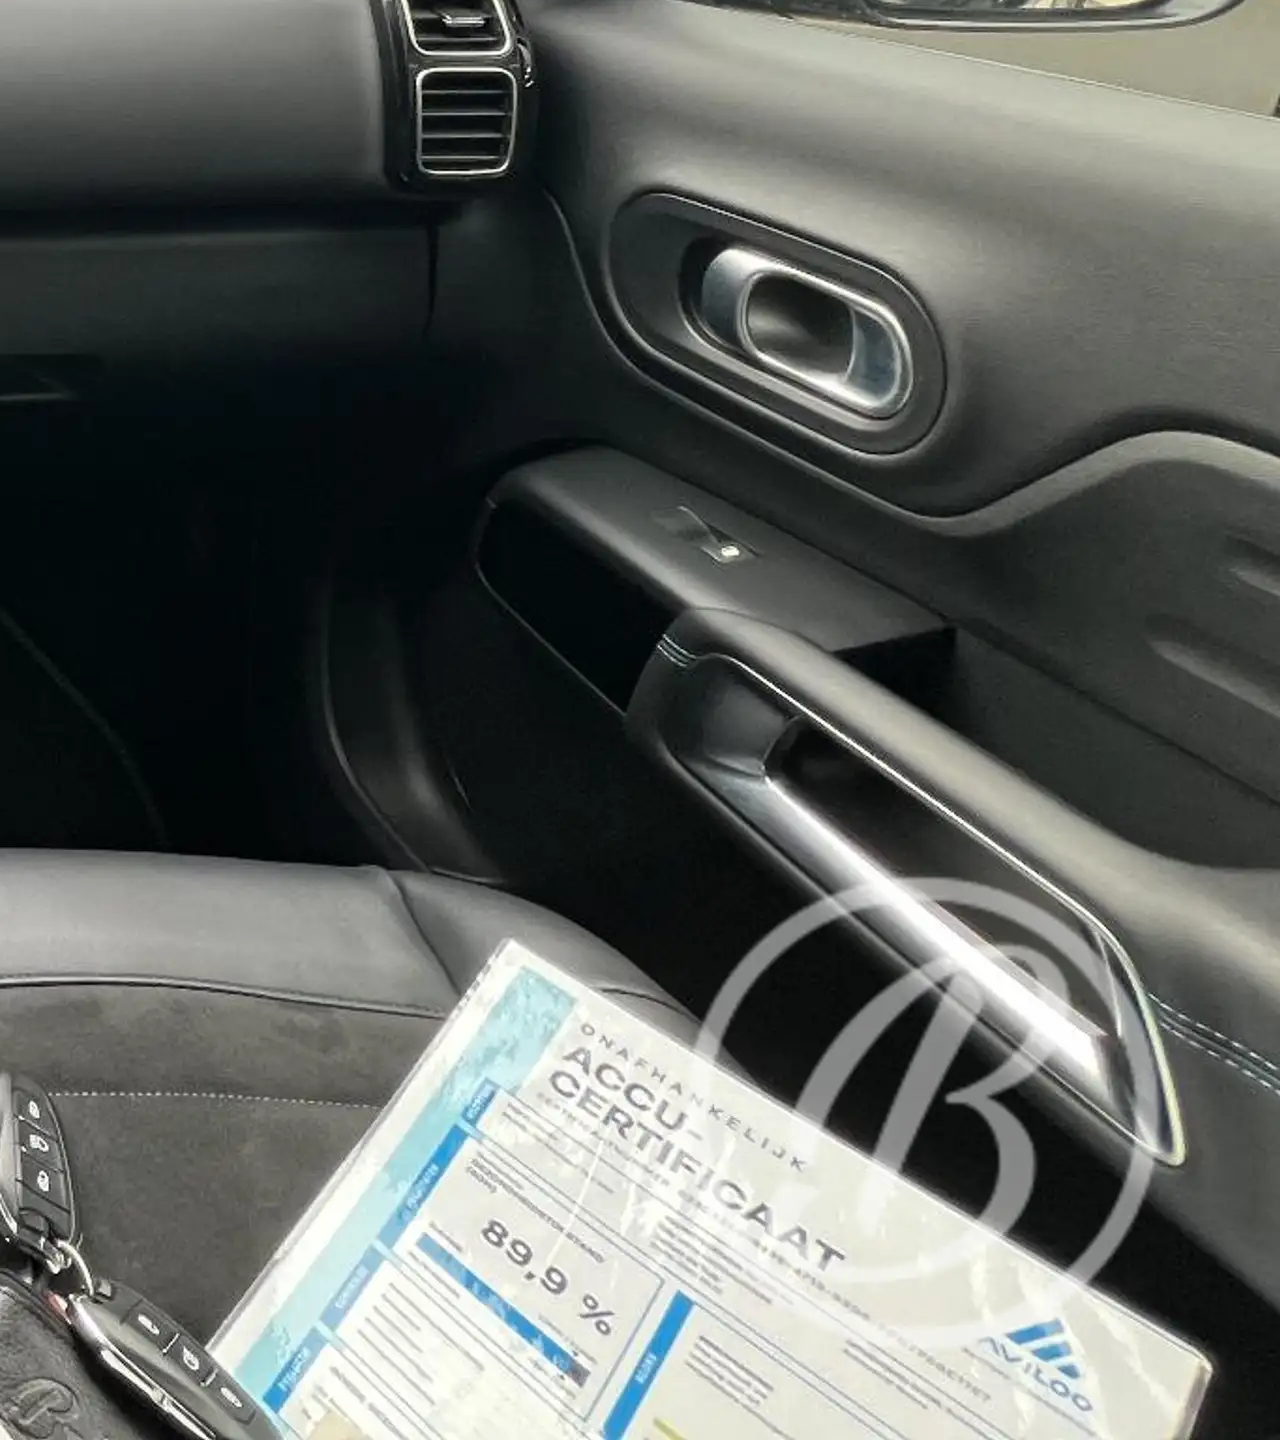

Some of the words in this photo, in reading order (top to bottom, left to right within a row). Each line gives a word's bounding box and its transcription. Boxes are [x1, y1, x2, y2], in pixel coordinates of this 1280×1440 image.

[561, 1046, 703, 1141] ACCU-
[580, 1022, 807, 1172] ONAFHANKELIJK
[548, 1069, 846, 1272] CERTIFICAAT
[480, 1220, 568, 1296] 89,9
[579, 1293, 615, 1337] %
